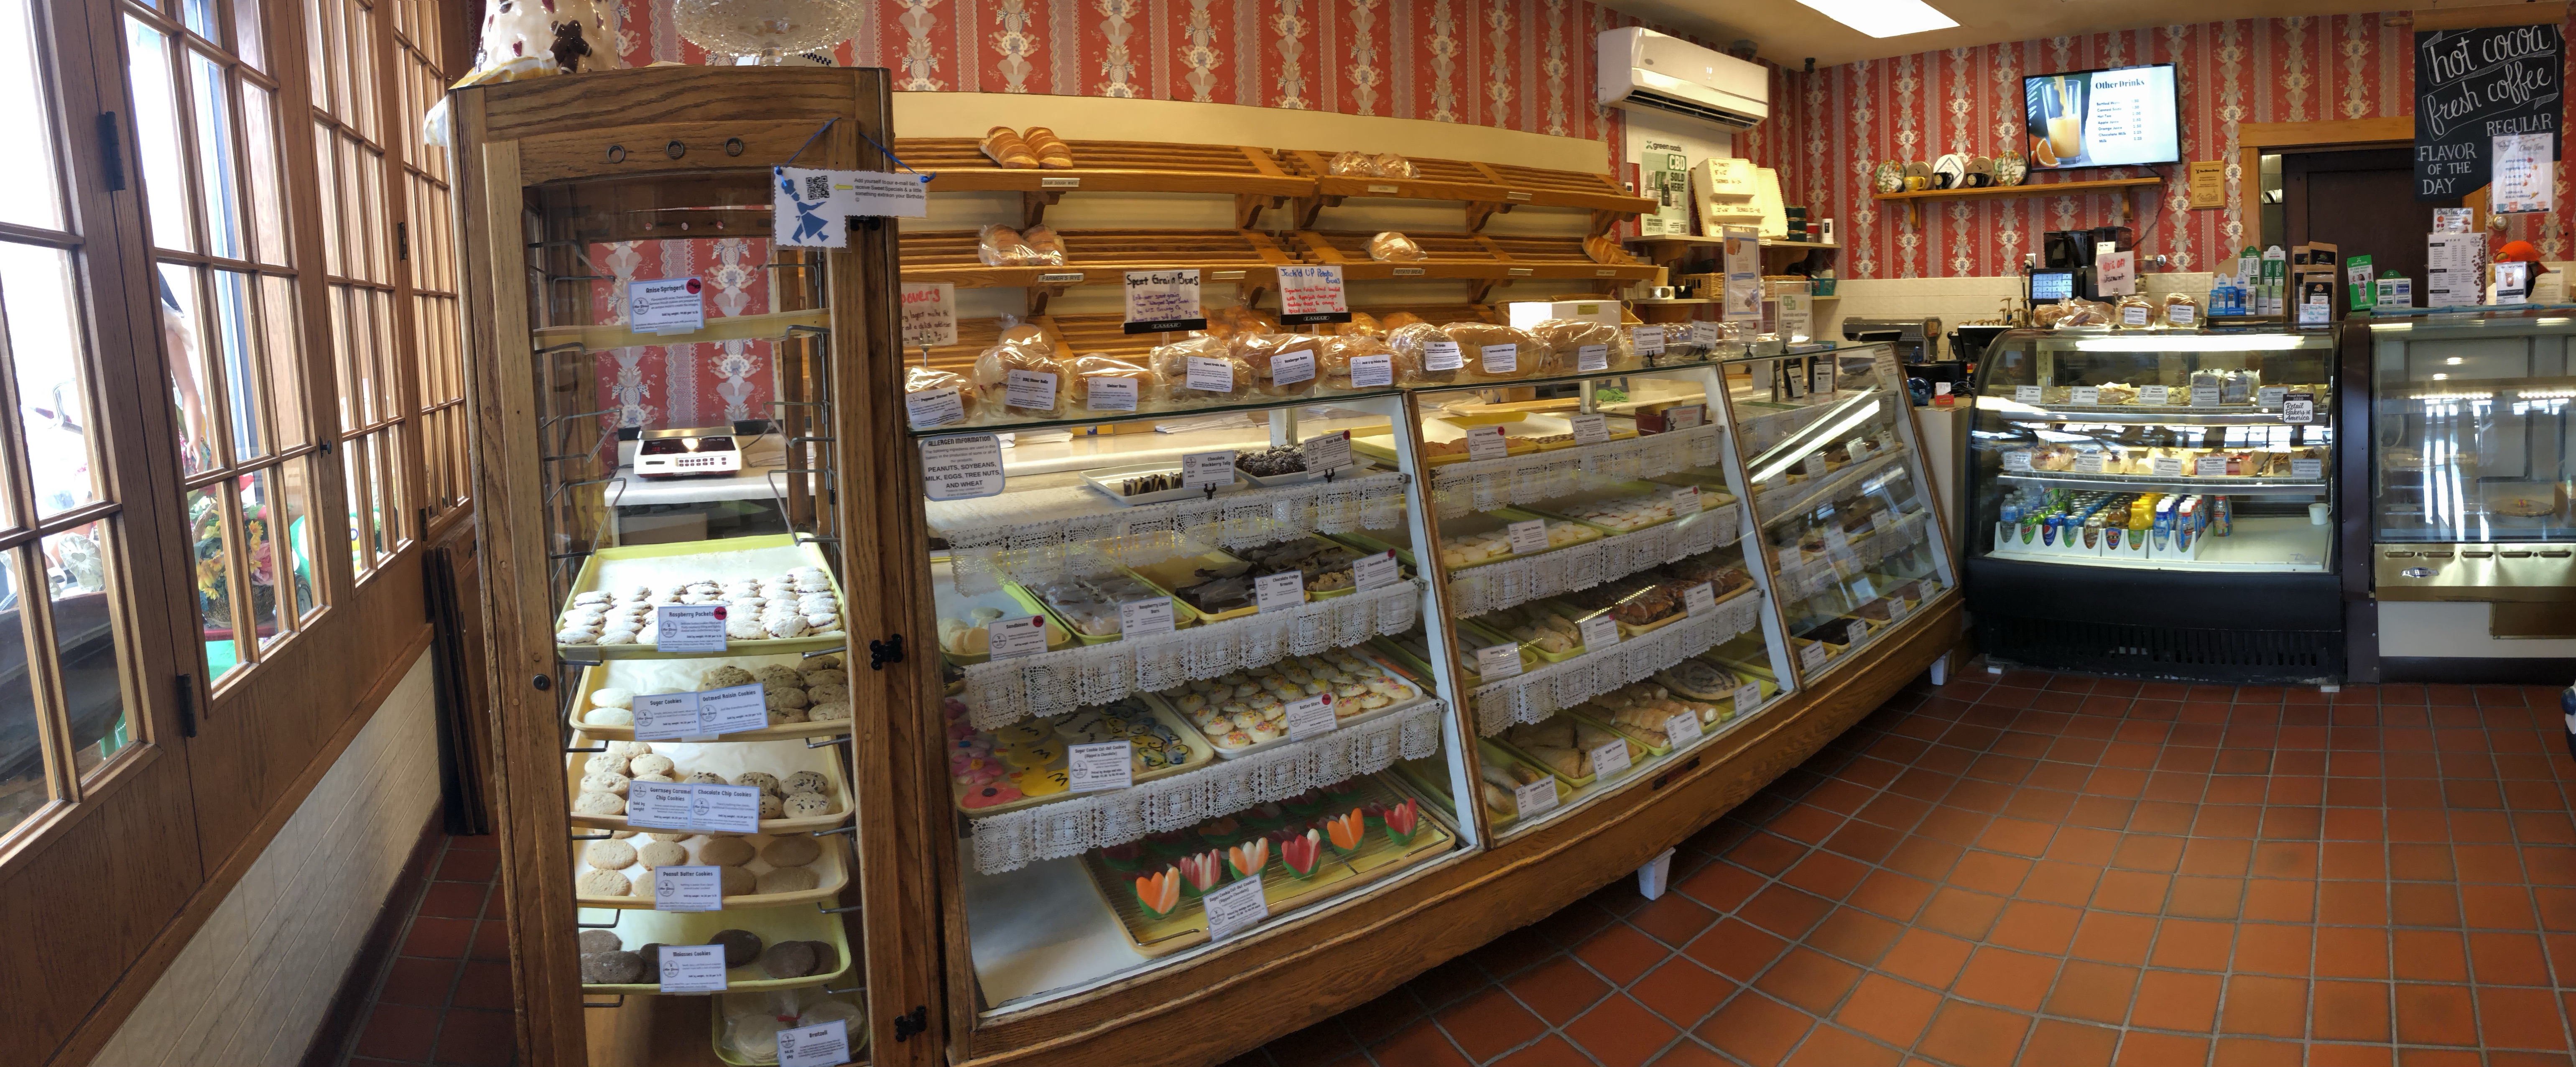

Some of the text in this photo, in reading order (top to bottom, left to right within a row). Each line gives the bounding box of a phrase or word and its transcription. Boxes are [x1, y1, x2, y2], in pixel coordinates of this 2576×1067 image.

[2431, 26, 2551, 83] hot cocoa
[2119, 79, 2145, 87] Drinks
[2427, 61, 2551, 135] fresh coffee
[2486, 113, 2553, 136] REGULAR
[2420, 143, 2477, 161] FLAVOR
[1669, 155, 1685, 171] CBD
[2428, 162, 2471, 175] OF THE
[1670, 172, 1685, 181] SOLD
[1670, 183, 1684, 192] HERE
[2423, 178, 2456, 194] DAY
[1127, 272, 1199, 288] Spent Grain Buns
[1280, 268, 1303, 277] Jack'd
[1317, 268, 1333, 277] Potato
[956, 436, 991, 444] INFORMATION
